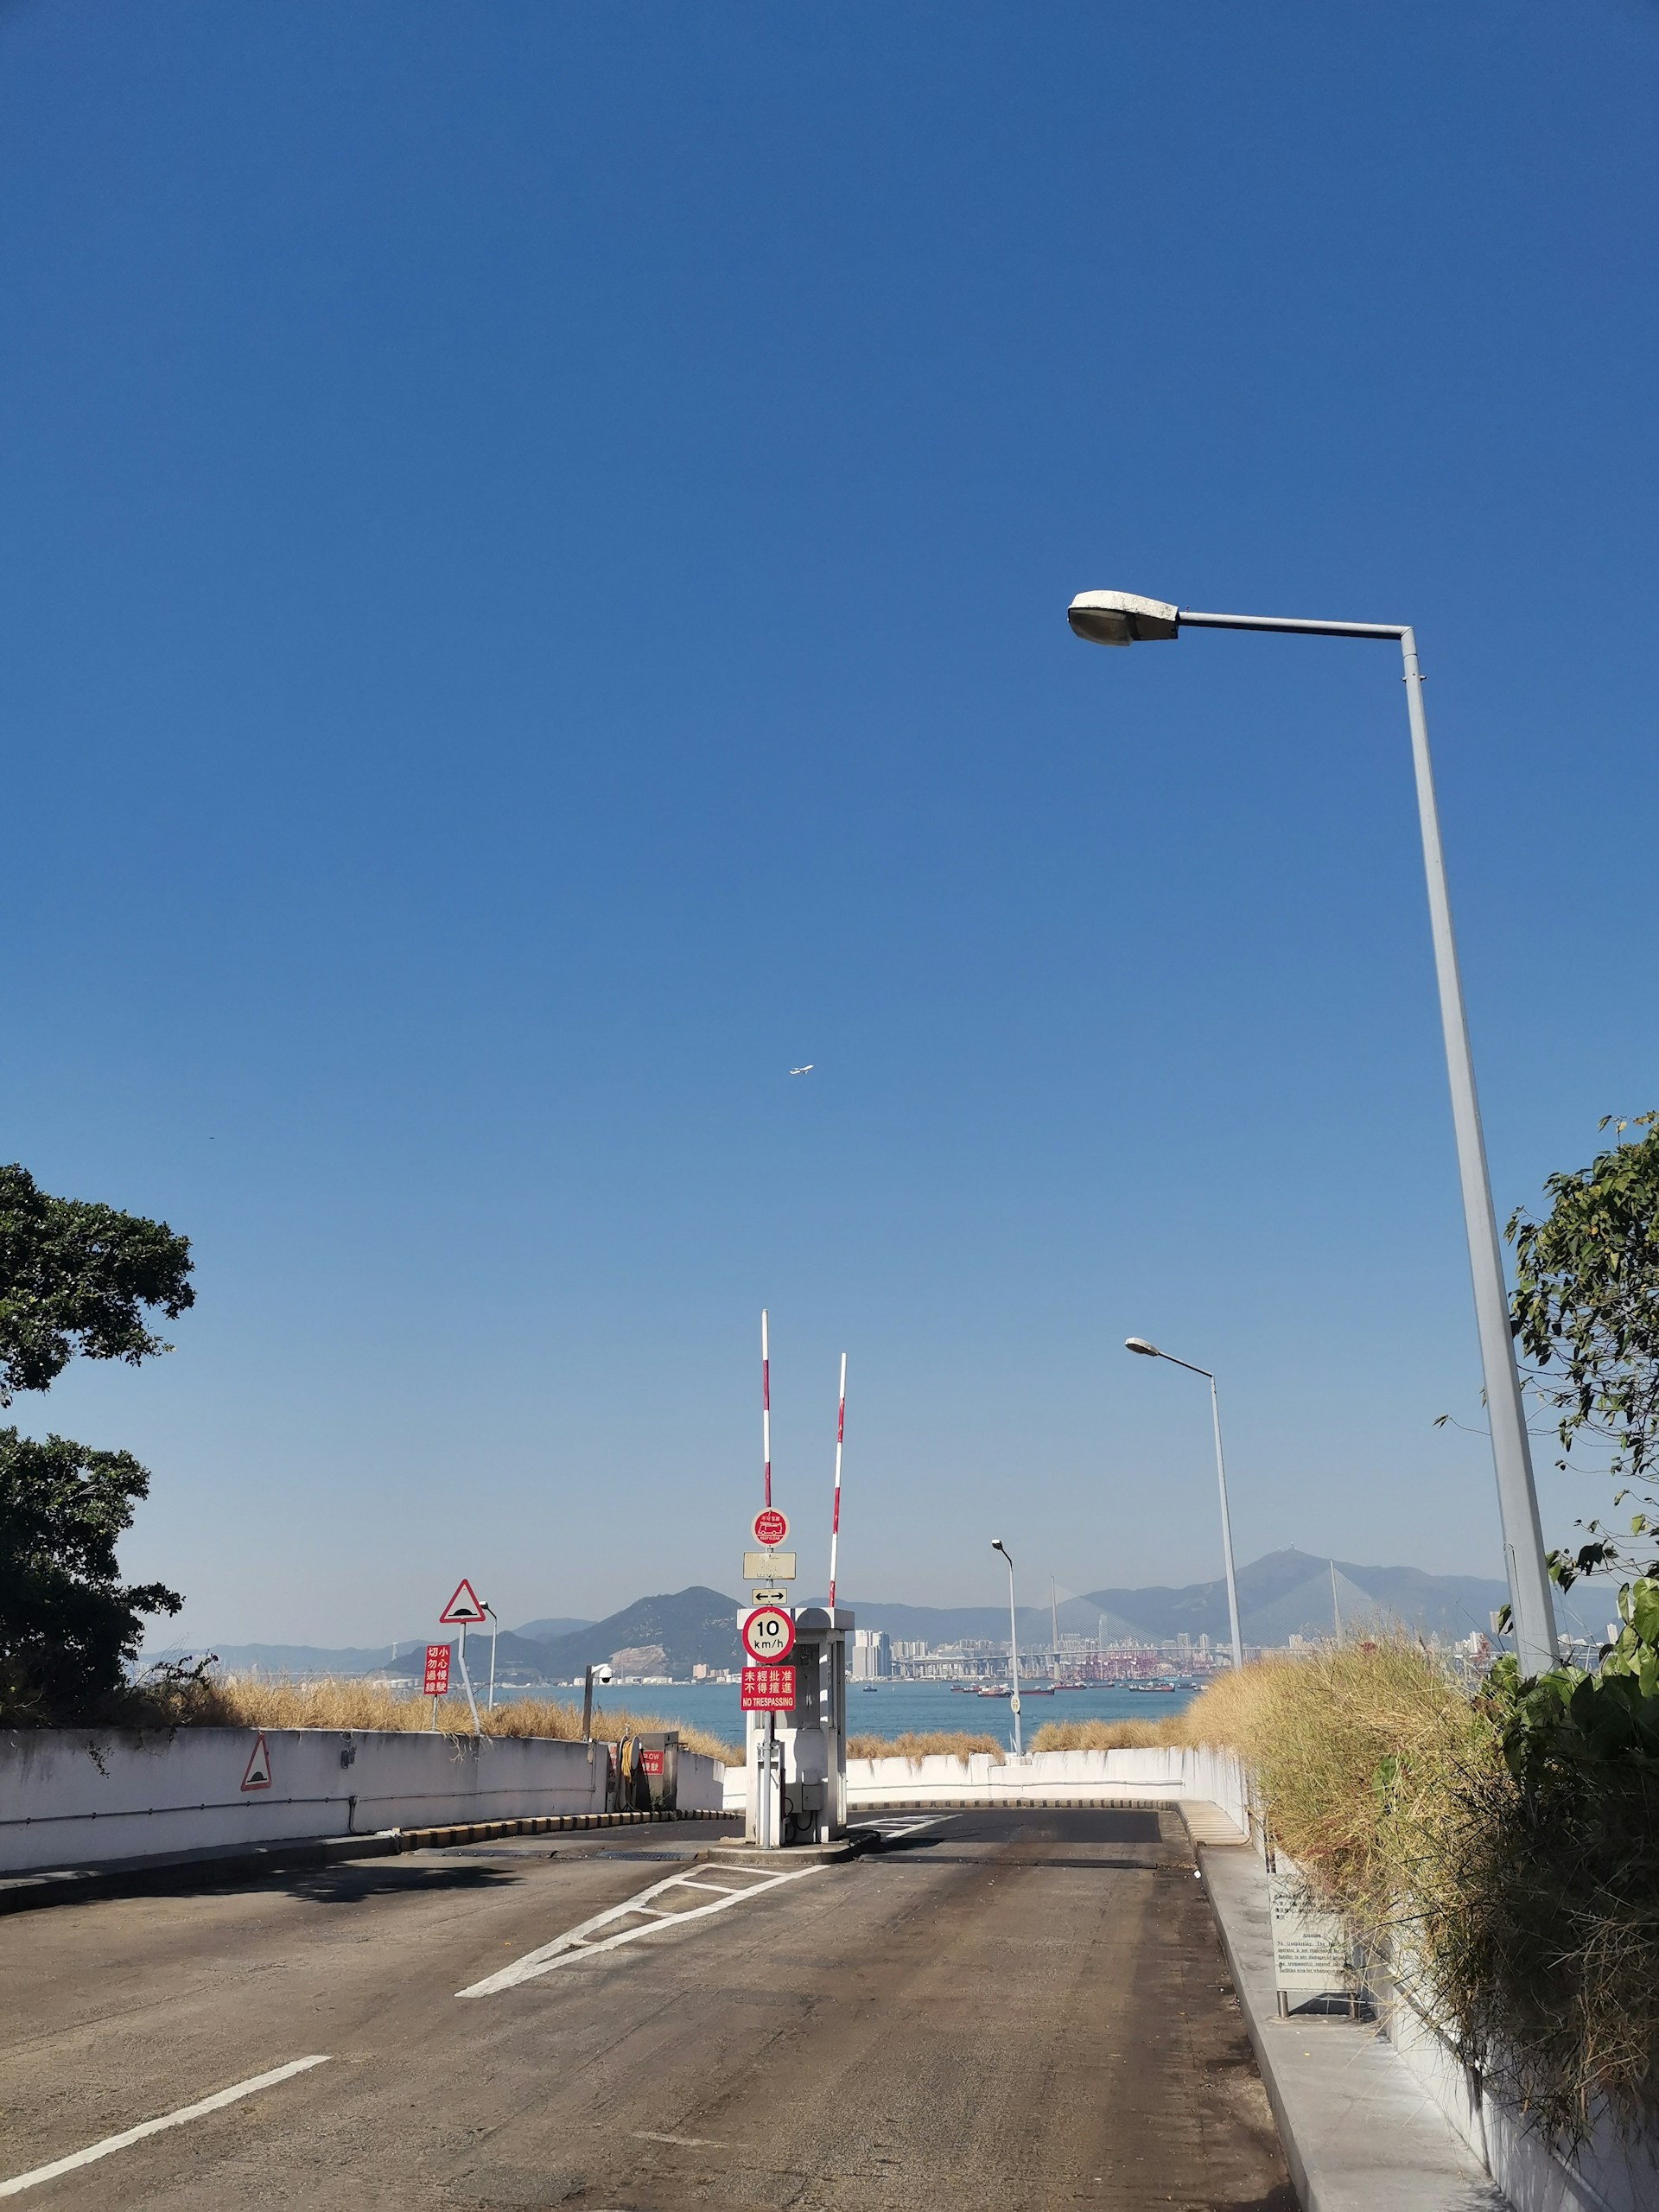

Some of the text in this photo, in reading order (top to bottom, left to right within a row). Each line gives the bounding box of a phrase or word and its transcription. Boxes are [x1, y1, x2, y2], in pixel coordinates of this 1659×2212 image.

[757, 1620, 779, 1637] 10
[754, 1639, 784, 1649] km/h
[436, 1647, 448, 1692] 小心慢駛
[744, 1670, 792, 1682] 未經批准
[743, 1698, 793, 1707] NO TRESPASSING
